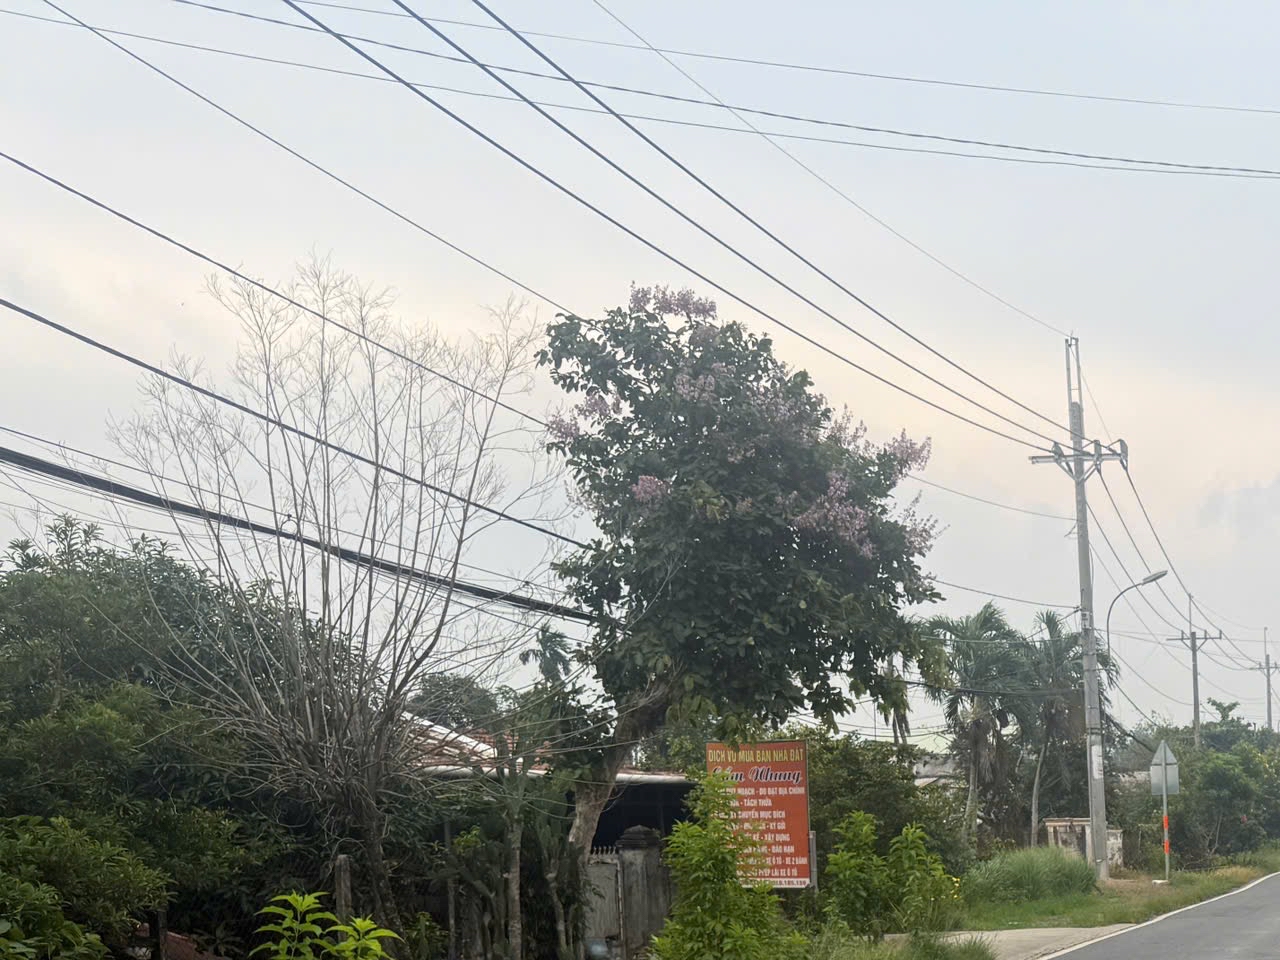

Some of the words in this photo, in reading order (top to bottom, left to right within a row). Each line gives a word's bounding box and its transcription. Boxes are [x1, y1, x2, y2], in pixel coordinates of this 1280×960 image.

[708, 750, 725, 765] DỊCH
[738, 750, 754, 762] MUA
[749, 766, 803, 784] Nhung
